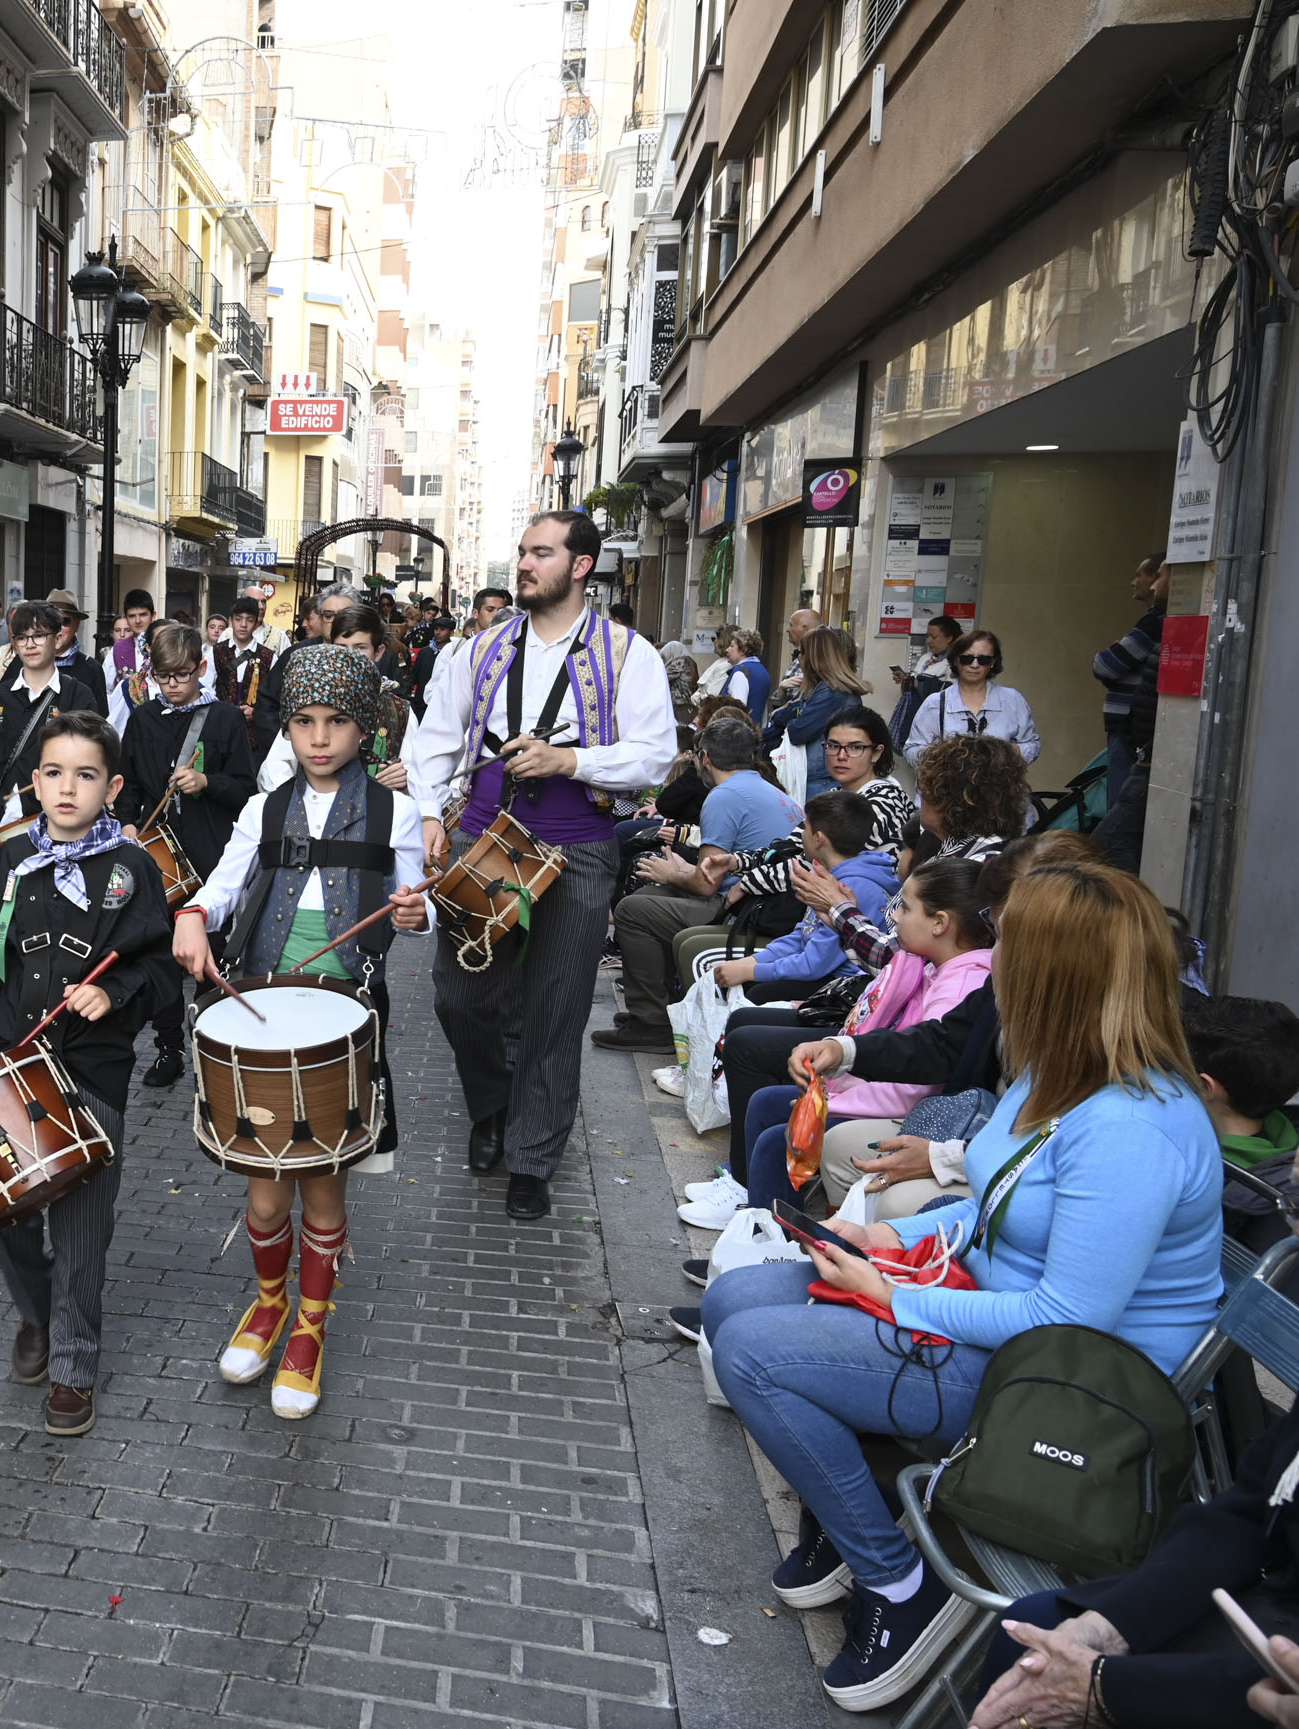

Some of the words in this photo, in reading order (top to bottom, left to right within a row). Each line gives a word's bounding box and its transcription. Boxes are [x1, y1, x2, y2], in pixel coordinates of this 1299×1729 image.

[278, 403, 294, 416] SE
[297, 403, 338, 416] VENDE
[281, 416, 334, 428] EDIFICIO
[367, 432, 377, 473] OFICINAS
[366, 475, 375, 516] ALQUILER
[1179, 488, 1211, 506] NOTARIOS
[230, 552, 243, 565] 964
[245, 552, 254, 565] 22
[255, 552, 265, 565] 63
[266, 552, 275, 565] 08
[1033, 1441, 1085, 1466] MOOS
